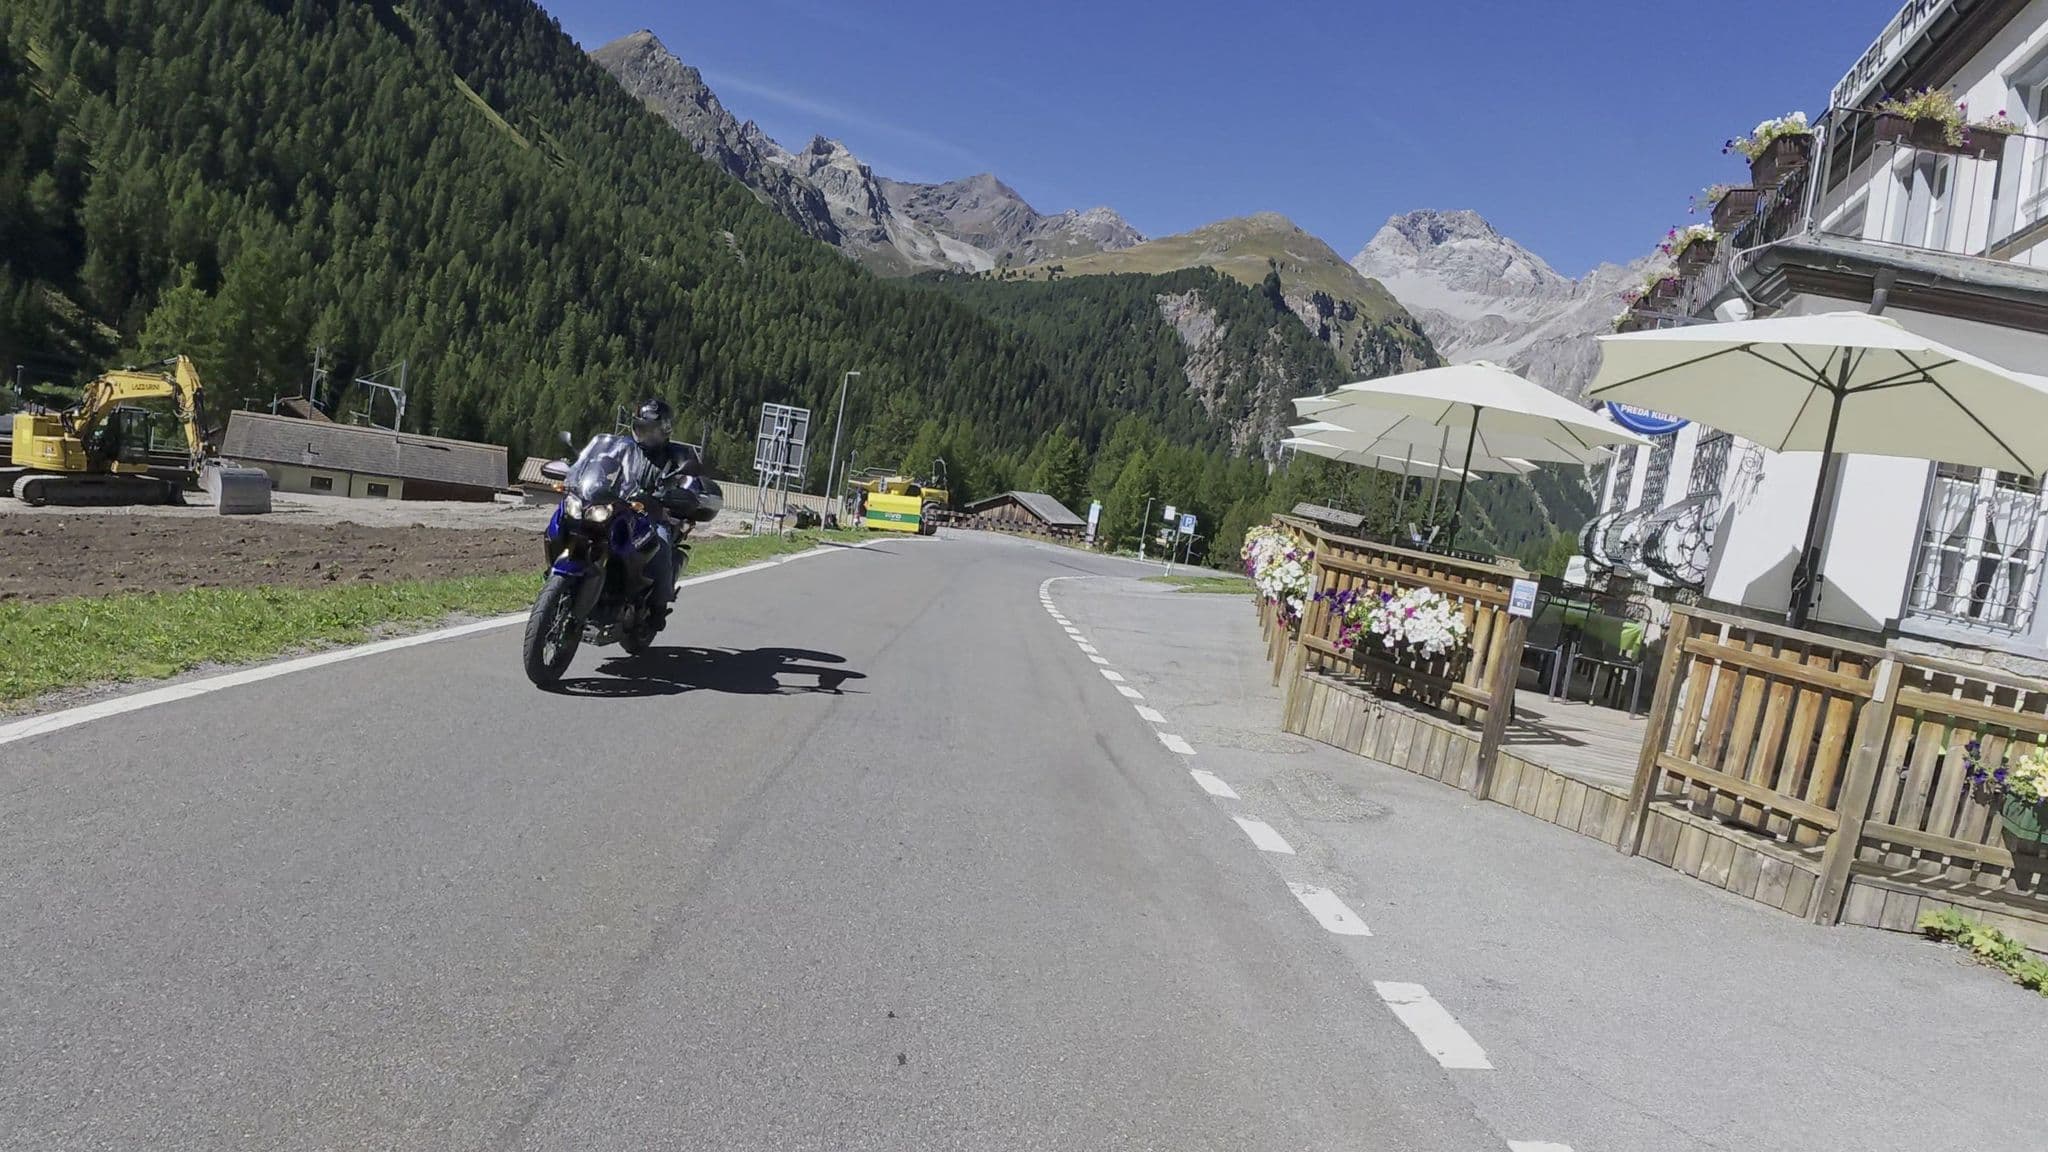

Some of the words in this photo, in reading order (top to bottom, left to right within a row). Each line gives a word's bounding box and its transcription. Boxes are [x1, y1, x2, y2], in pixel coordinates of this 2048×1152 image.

[1834, 36, 1888, 106] HOTEL
[1620, 404, 1650, 417] PREDA
[1651, 411, 1678, 423] KULM
[1185, 517, 1193, 528] P
